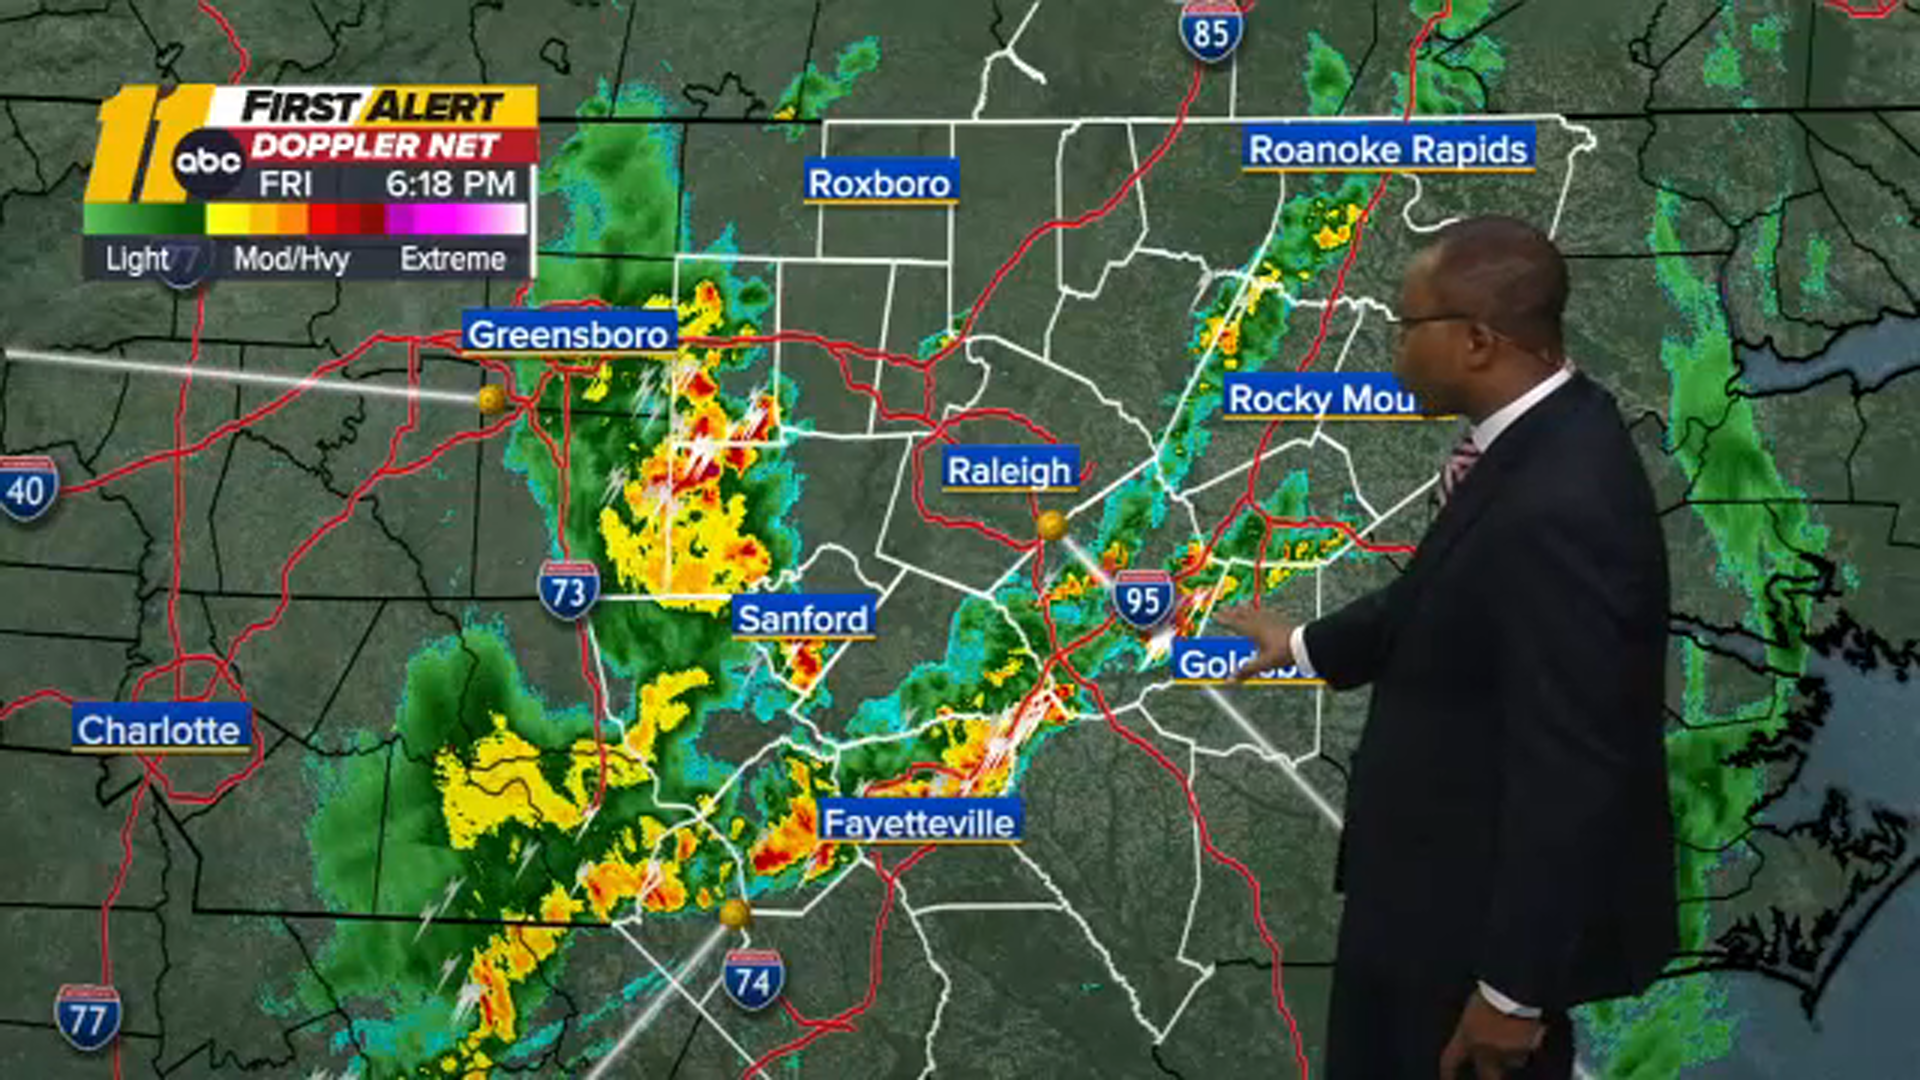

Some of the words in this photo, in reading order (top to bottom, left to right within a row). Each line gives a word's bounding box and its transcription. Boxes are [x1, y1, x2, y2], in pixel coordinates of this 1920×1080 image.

[1194, 19, 1229, 48] 85
[1250, 134, 1400, 163] Roanoke
[1412, 134, 1528, 168] Rapids
[809, 168, 951, 198] Roxboro
[468, 320, 669, 349] Greensboro
[1229, 384, 1333, 418] Rocky
[1342, 384, 1415, 413] Mou
[948, 456, 1071, 492] Raleigh
[6, 475, 44, 506] 40
[551, 578, 584, 607] 73
[1127, 587, 1160, 615] 95
[738, 604, 868, 633] Sanford
[77, 714, 241, 745] Charlotte
[824, 808, 1016, 841] Fayetteville
[735, 967, 769, 997] 74
[69, 1004, 107, 1035] 77
